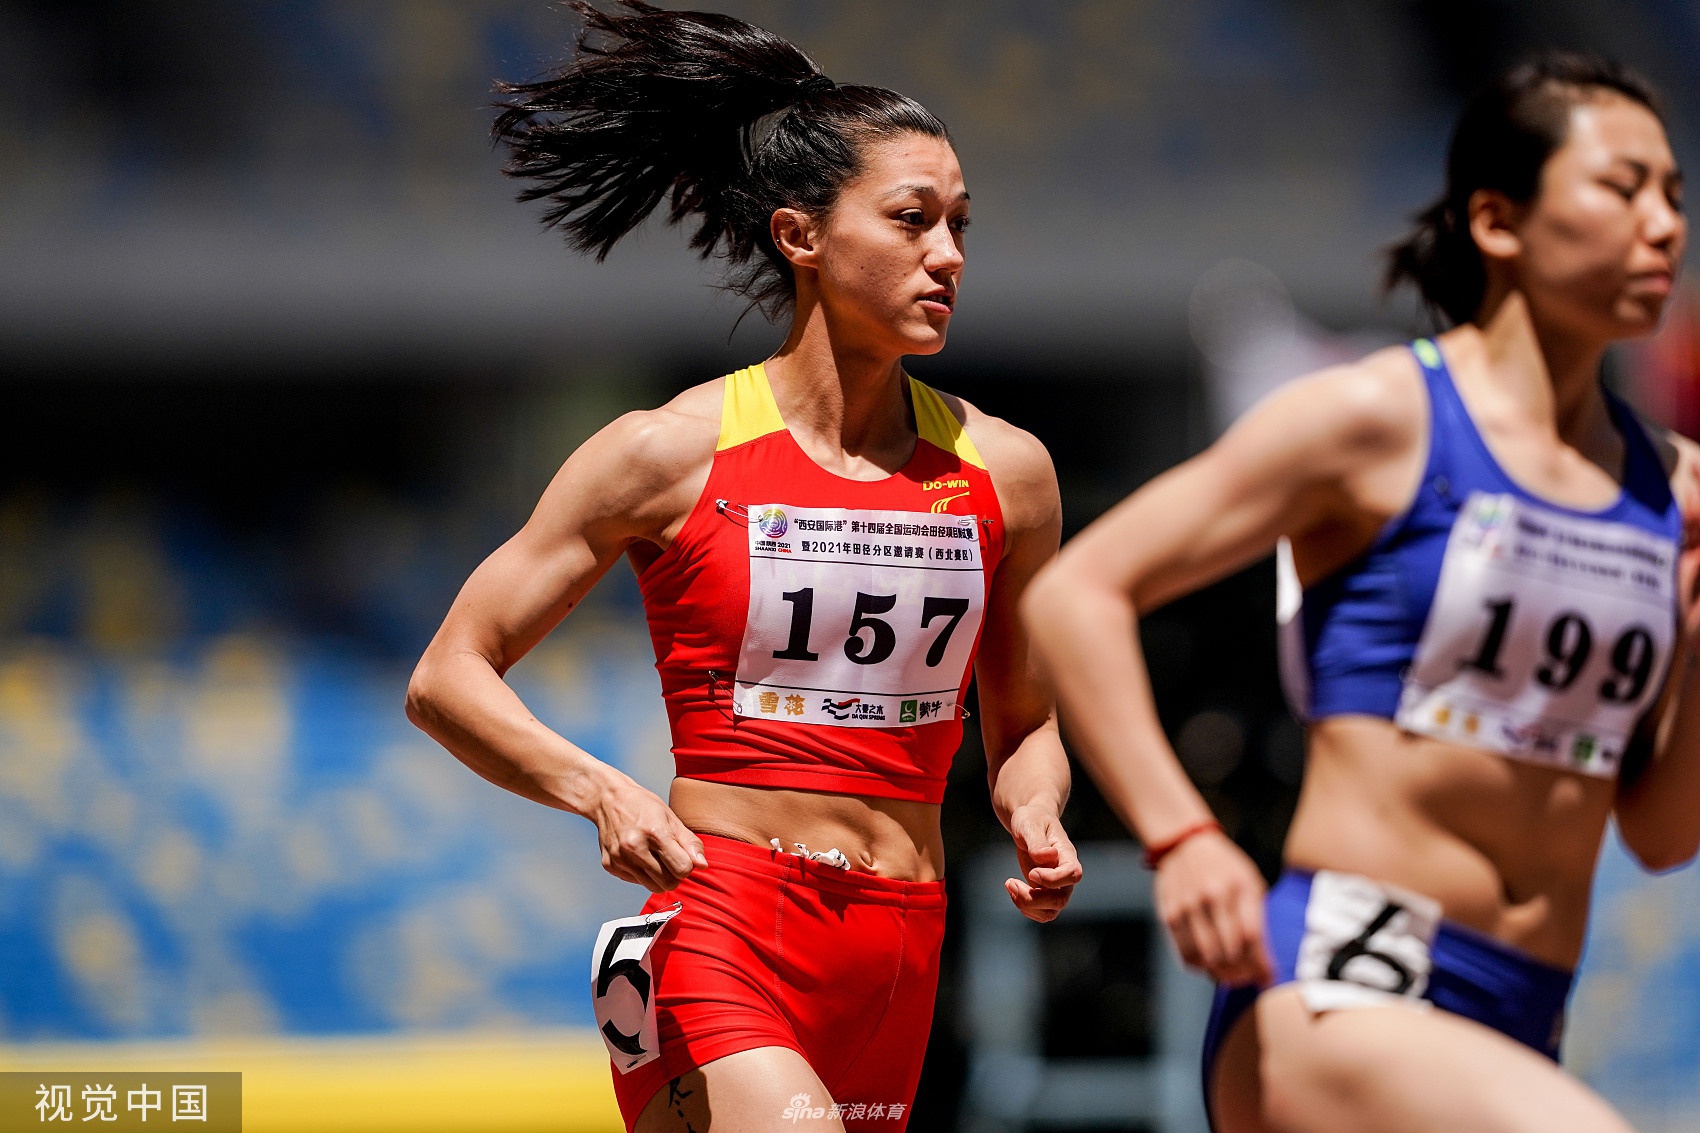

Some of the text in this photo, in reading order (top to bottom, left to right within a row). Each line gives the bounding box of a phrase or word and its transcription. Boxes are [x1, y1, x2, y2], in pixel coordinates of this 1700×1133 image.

[923, 479, 969, 491] DO-WIN
[772, 587, 970, 668] 157
[1455, 595, 1656, 704] 199
[597, 920, 668, 1056] 5
[1325, 901, 1414, 994] 6
